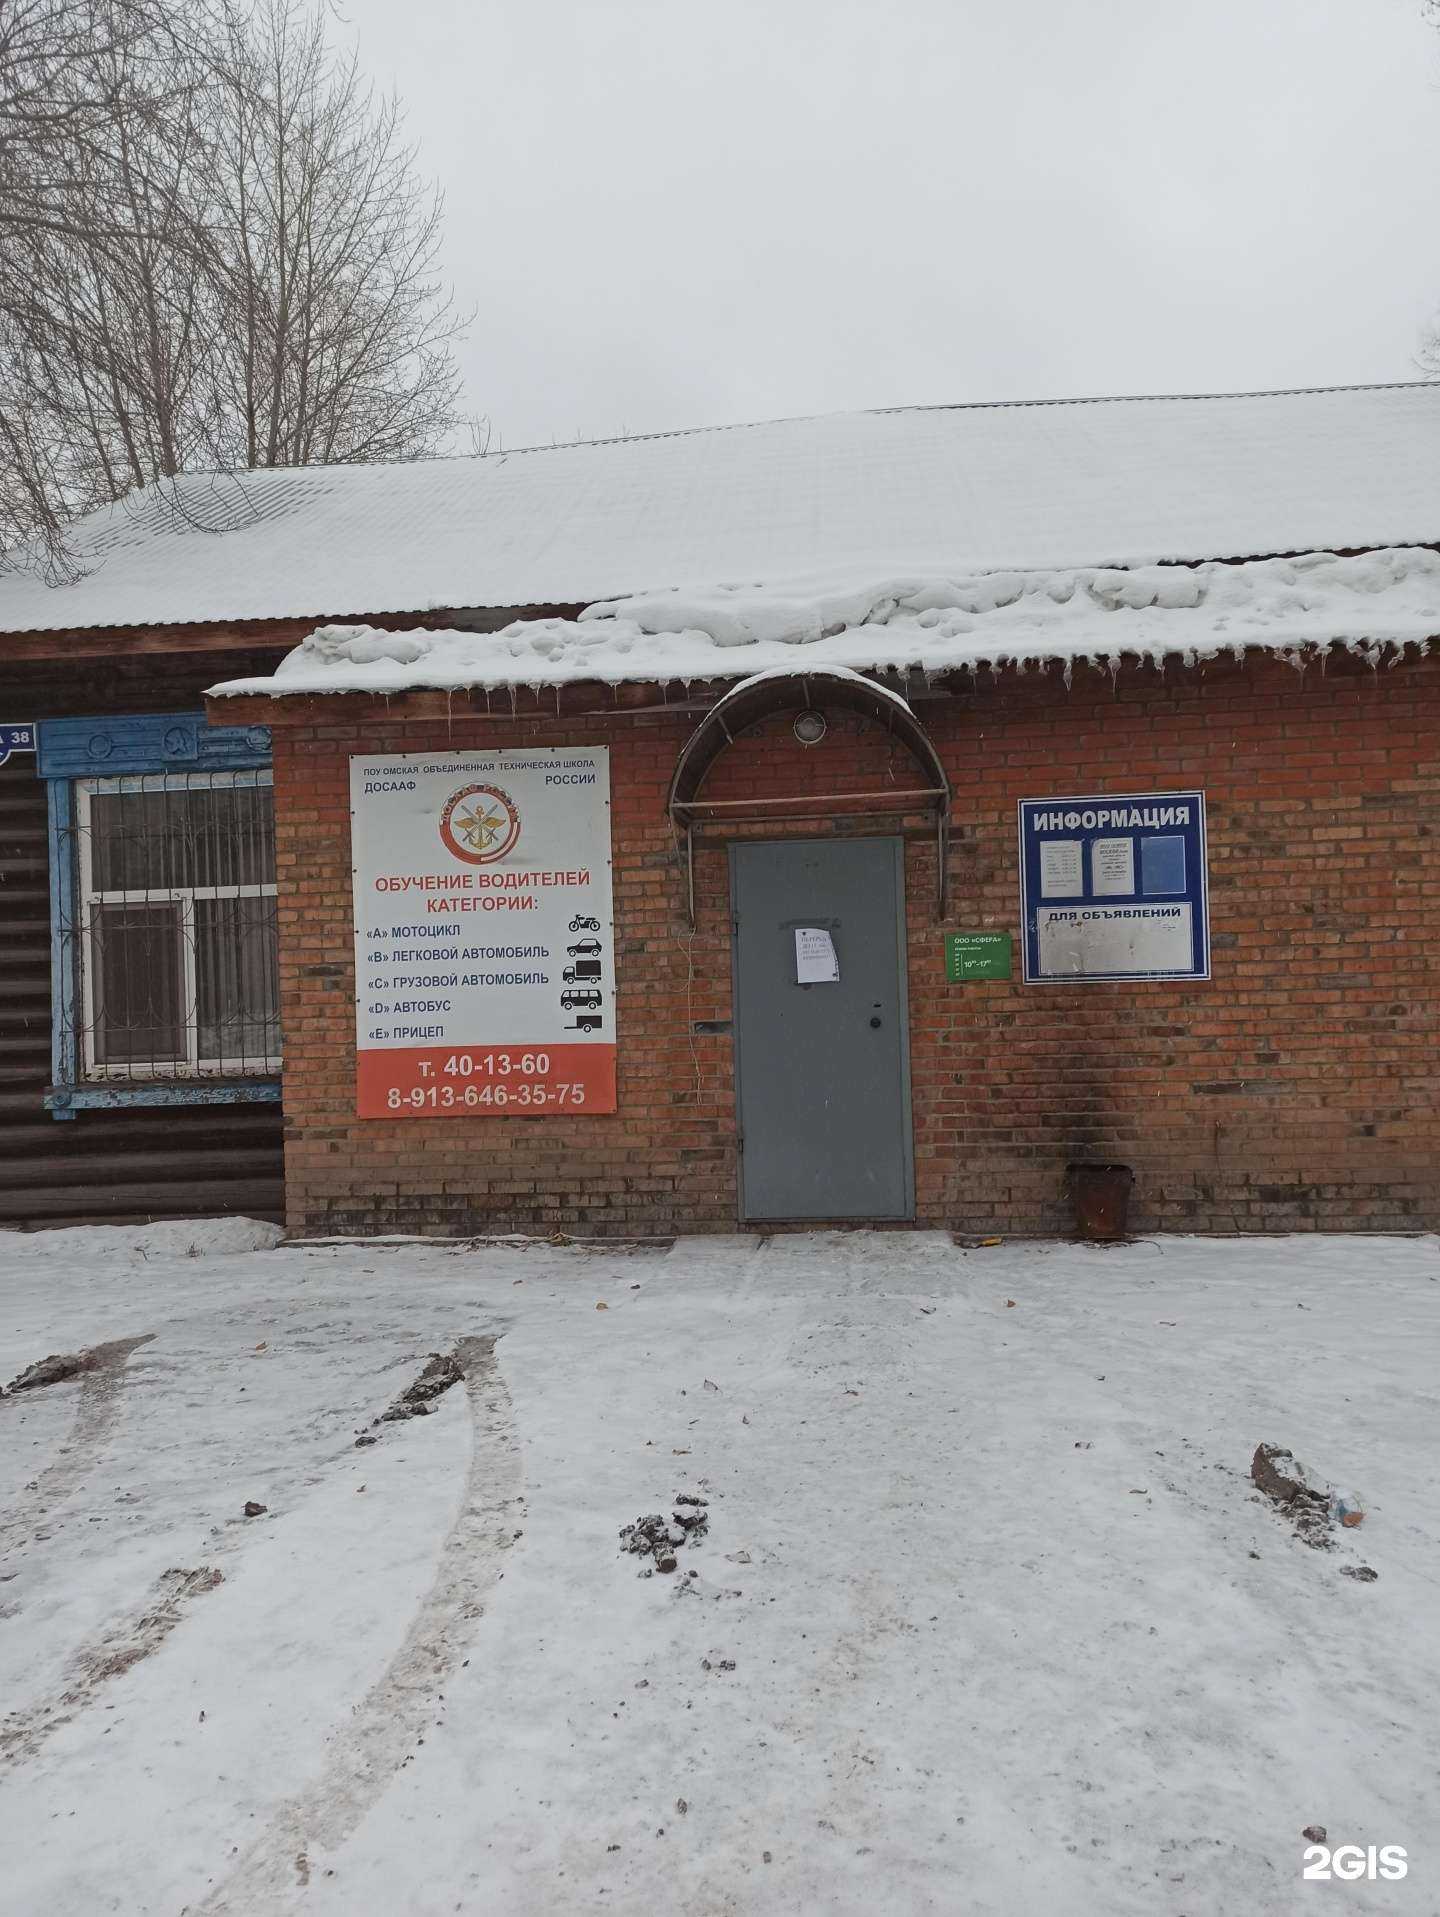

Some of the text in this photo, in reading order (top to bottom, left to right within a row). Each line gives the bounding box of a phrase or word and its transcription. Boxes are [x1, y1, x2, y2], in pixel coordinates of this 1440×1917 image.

[10, 731, 30, 744] 38
[363, 759, 595, 776] ПОУ ОМСКАЯ ОБЪЕДИНЕННАЯ ТЕХНИЧЕСКАЯ ШКОЛА
[545, 774, 596, 785] РОССИИ
[364, 781, 416, 794] ДОСААФ
[1033, 806, 1190, 831] ИНФОРМАЦИЯ
[375, 867, 590, 893] ОБУЧЕНИЕ ВОДИТЕЛЕЙ
[427, 896, 539, 913] КАТЕГОРИИ:
[1049, 906, 1181, 921] ДЛЯ ОБЪЯВЛЕНИЙ
[391, 925, 461, 938] МОТОЦИКЛ
[392, 946, 459, 962] ЛЕГКОВОЙ
[461, 946, 550, 960] АВТОМОБИЛЬ
[393, 973, 458, 988] ГРУЗОВОЙ
[461, 973, 549, 986] АВТОМОБИЛЬ
[368, 1000, 451, 1014] «D» АВТОБУС
[393, 1026, 444, 1039] ПРИЦЕП
[443, 1053, 550, 1077] 40-13-60
[387, 1083, 585, 1109] 8-913-646-35-75
